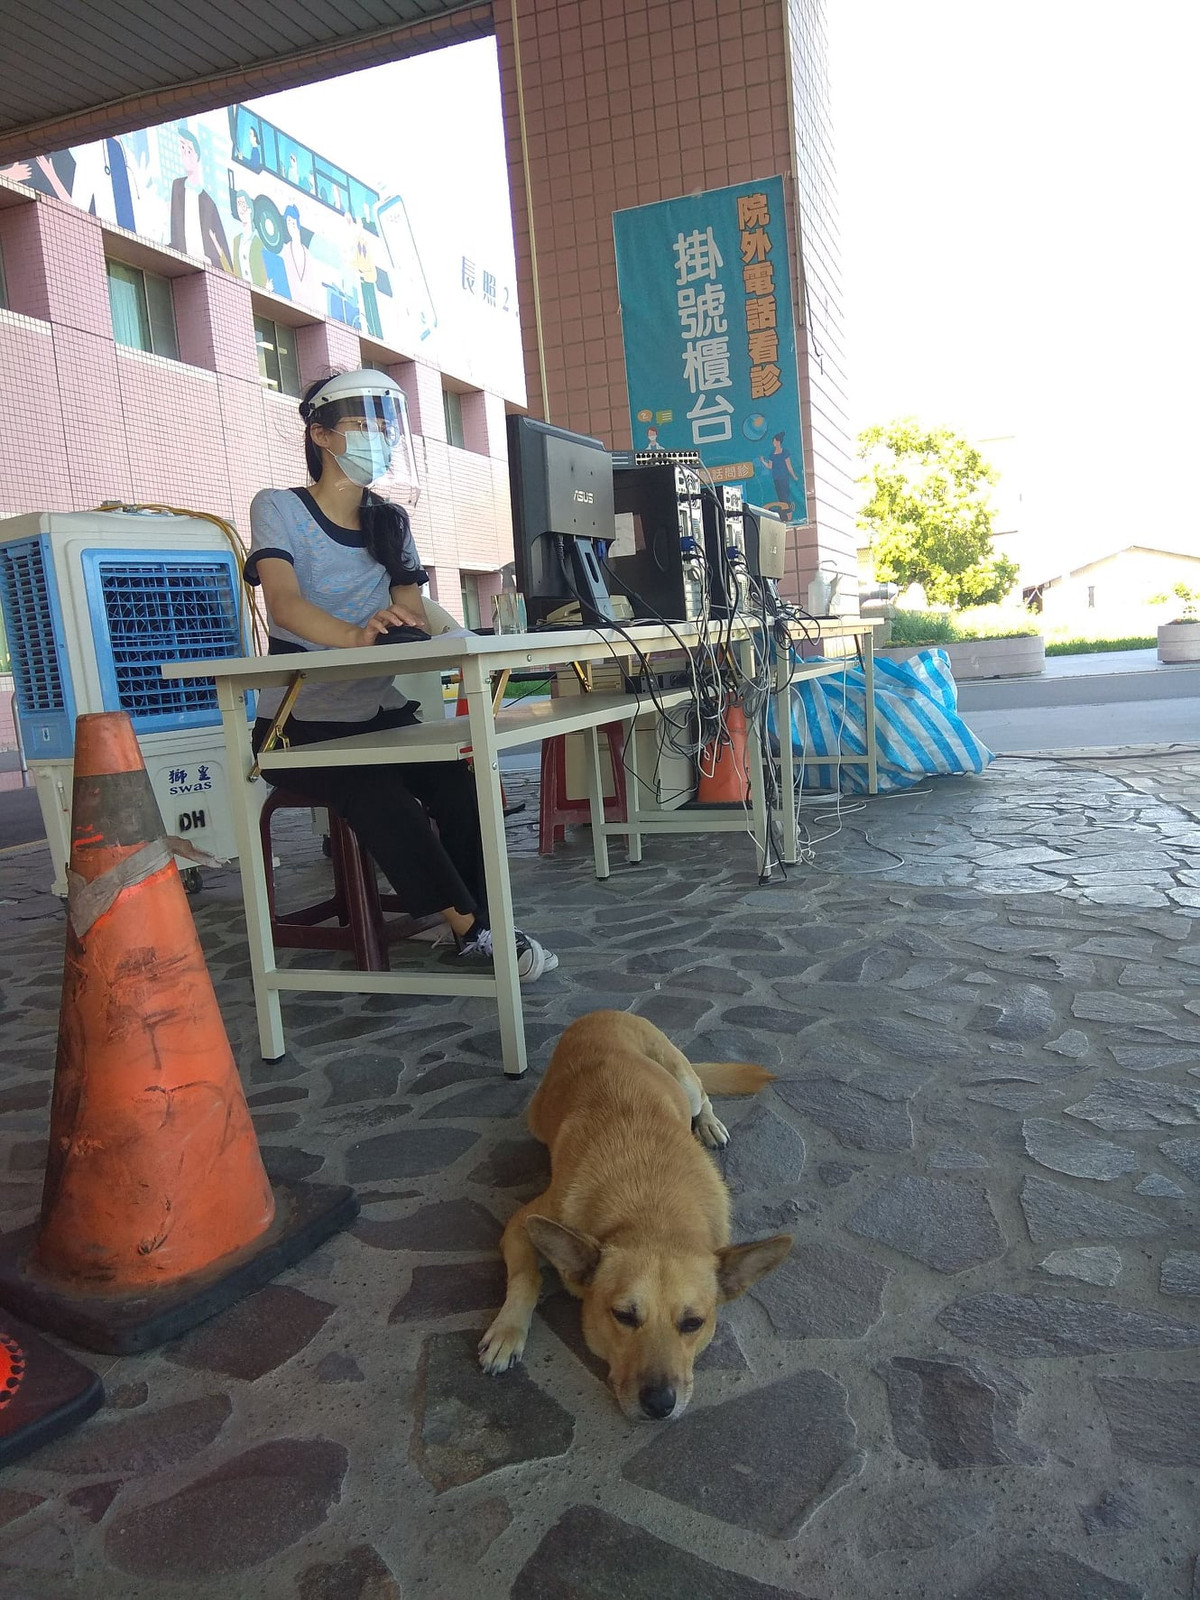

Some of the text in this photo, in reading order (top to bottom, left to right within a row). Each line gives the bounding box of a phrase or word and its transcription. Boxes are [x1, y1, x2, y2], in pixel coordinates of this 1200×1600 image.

[736, 193, 782, 400] 院外電話看診
[673, 226, 735, 445] 掛號櫃台
[573, 489, 594, 504] ASUS
[169, 781, 212, 795] swas
[179, 809, 206, 832] DH
